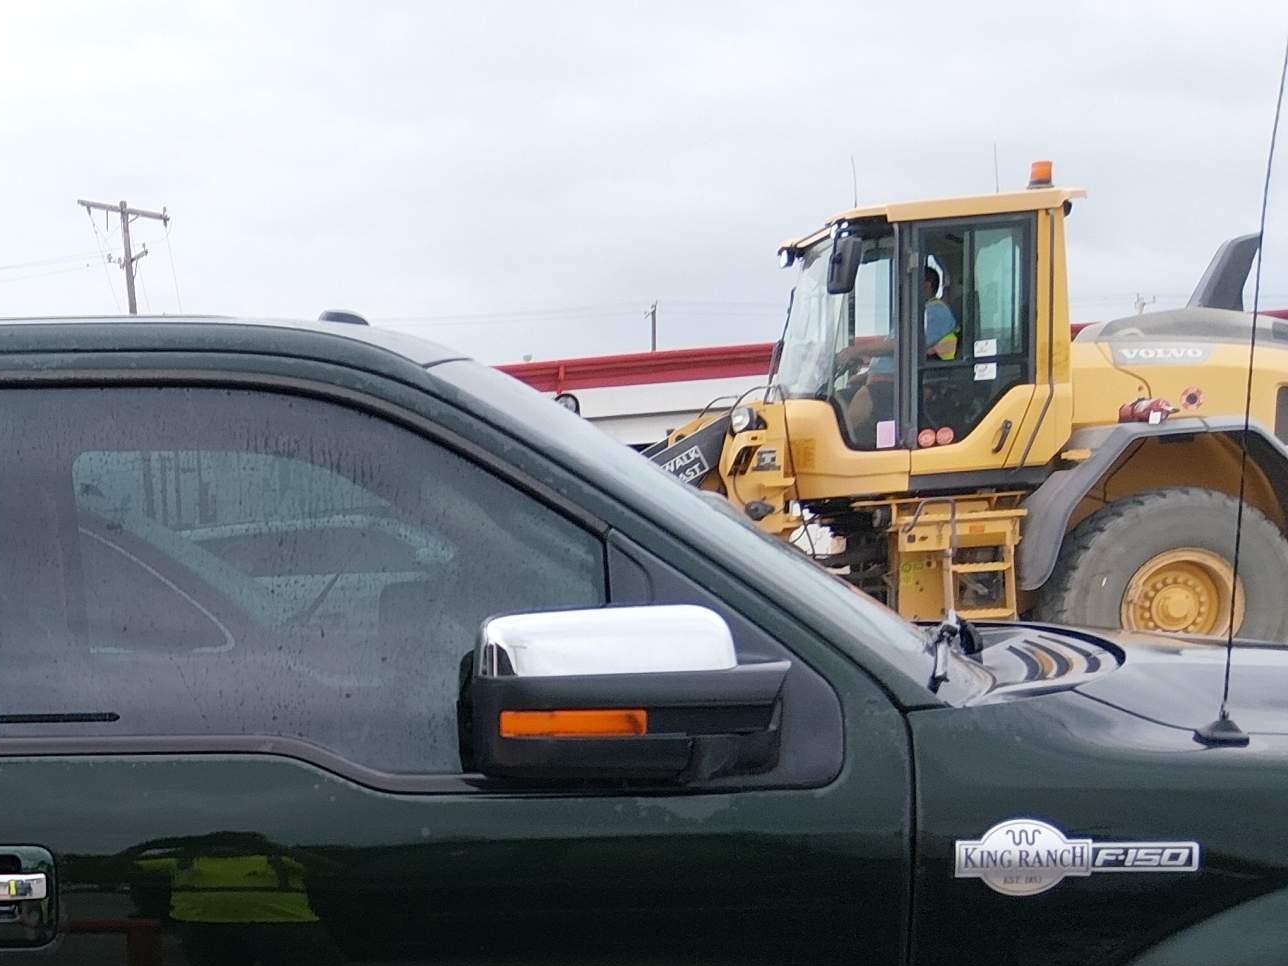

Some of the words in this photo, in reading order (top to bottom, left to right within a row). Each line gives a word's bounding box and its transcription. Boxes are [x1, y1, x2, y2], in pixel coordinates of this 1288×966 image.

[1119, 348, 1203, 358] VOLVO
[963, 847, 1012, 870] KING
[1018, 845, 1085, 868] RANCH
